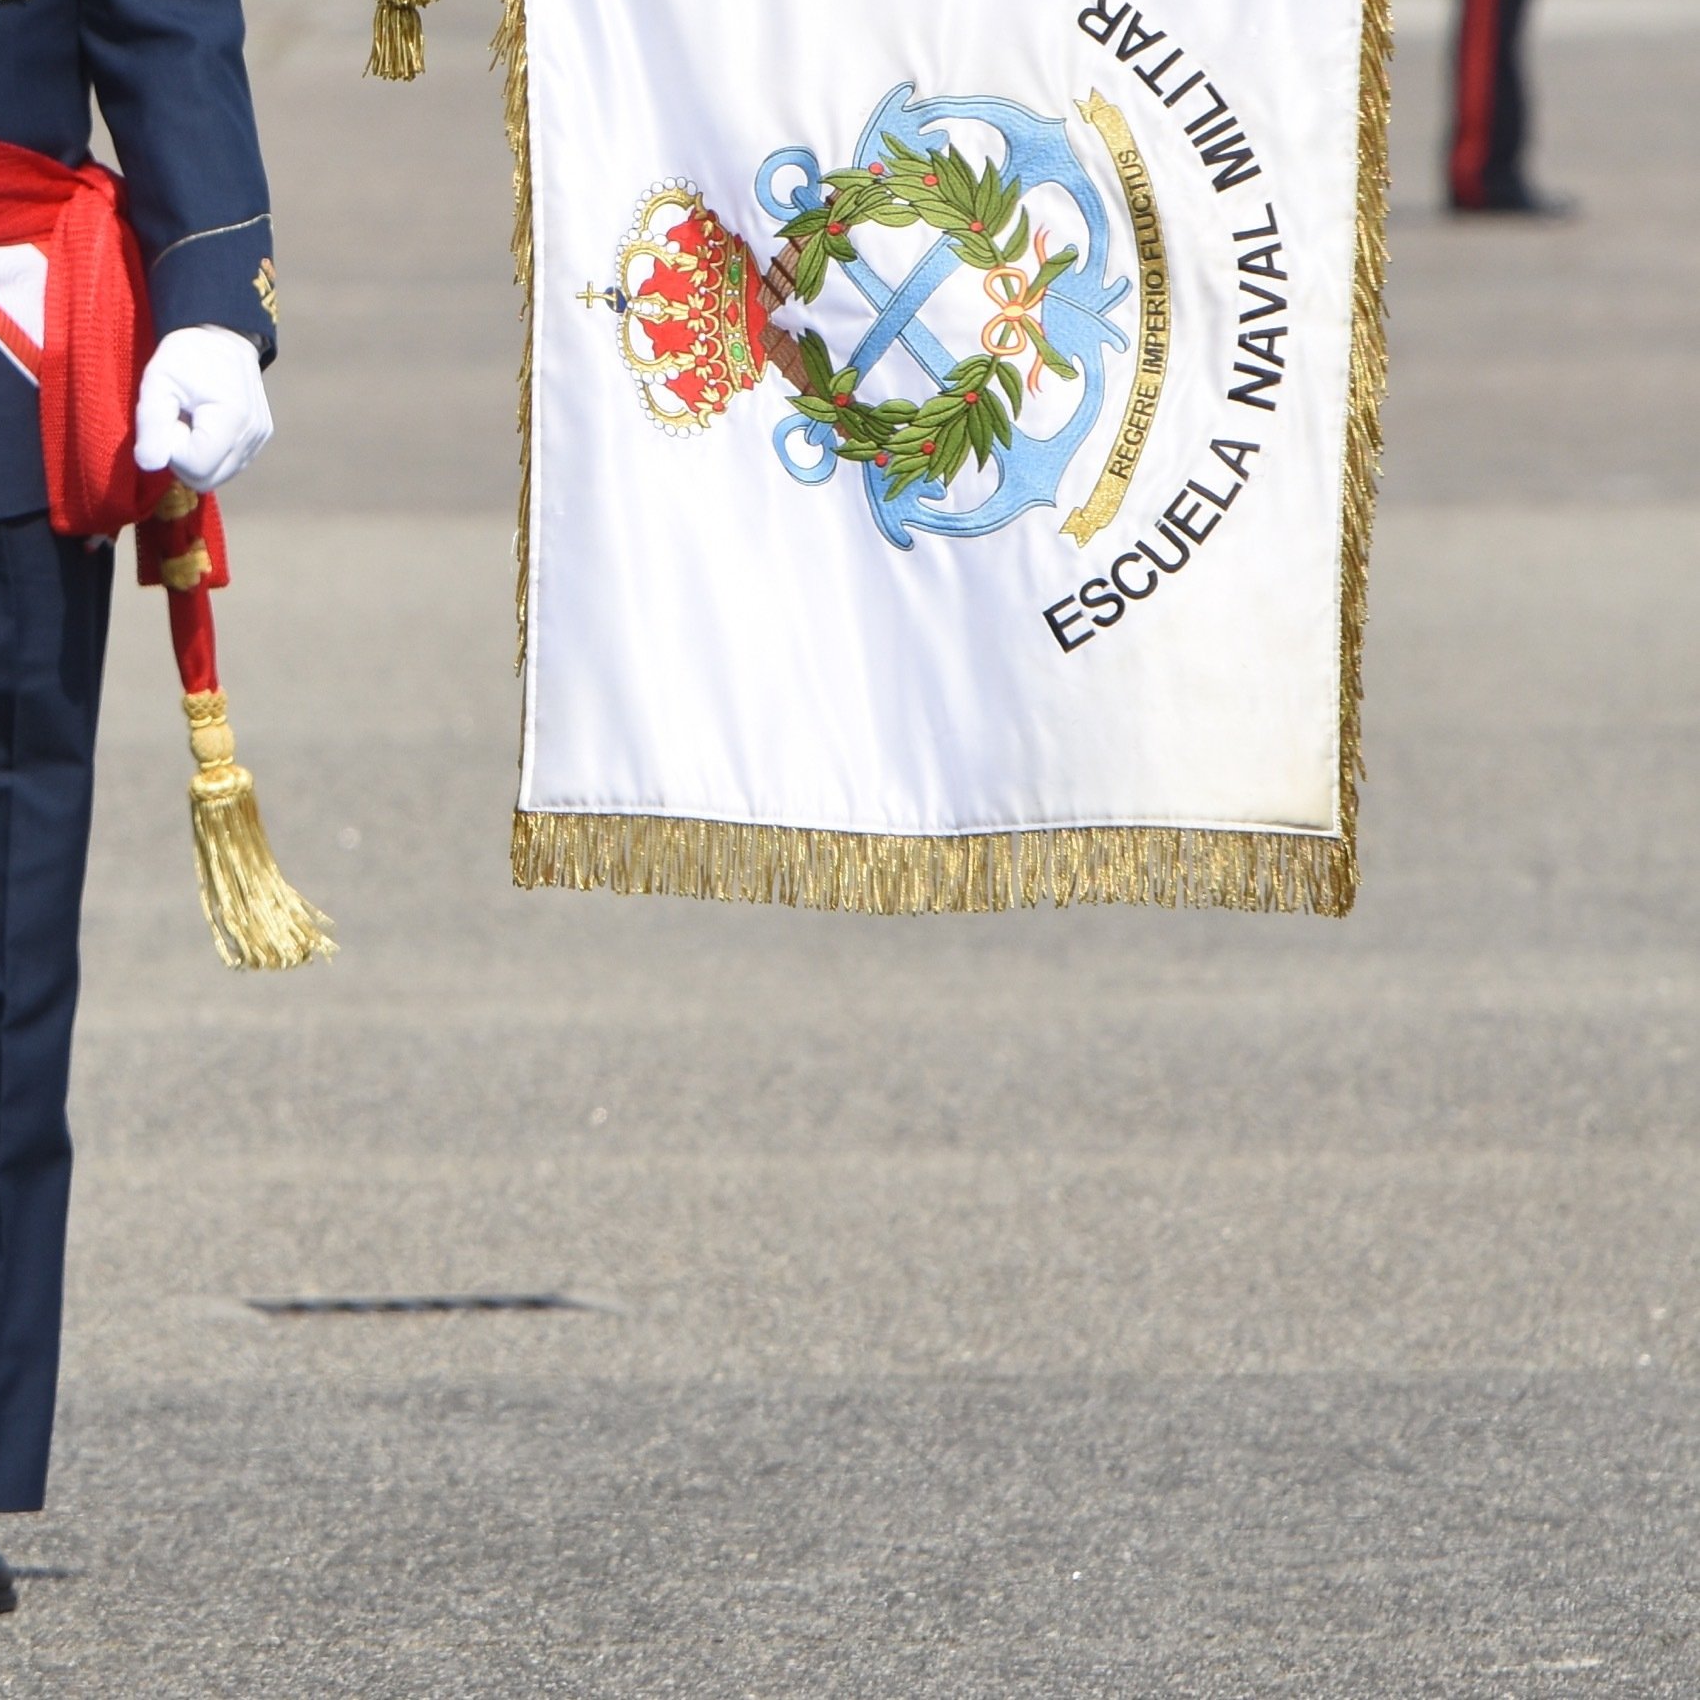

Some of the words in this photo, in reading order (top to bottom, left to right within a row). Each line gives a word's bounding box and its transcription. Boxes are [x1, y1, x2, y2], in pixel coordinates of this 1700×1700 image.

[1117, 148, 1161, 262] FLUCTUS
[1140, 270, 1167, 375] IMPERIO
[1042, 438, 1261, 654] ESCUELA
[1227, 202, 1290, 412] NAVAL
[1107, 385, 1159, 481] REGERE
